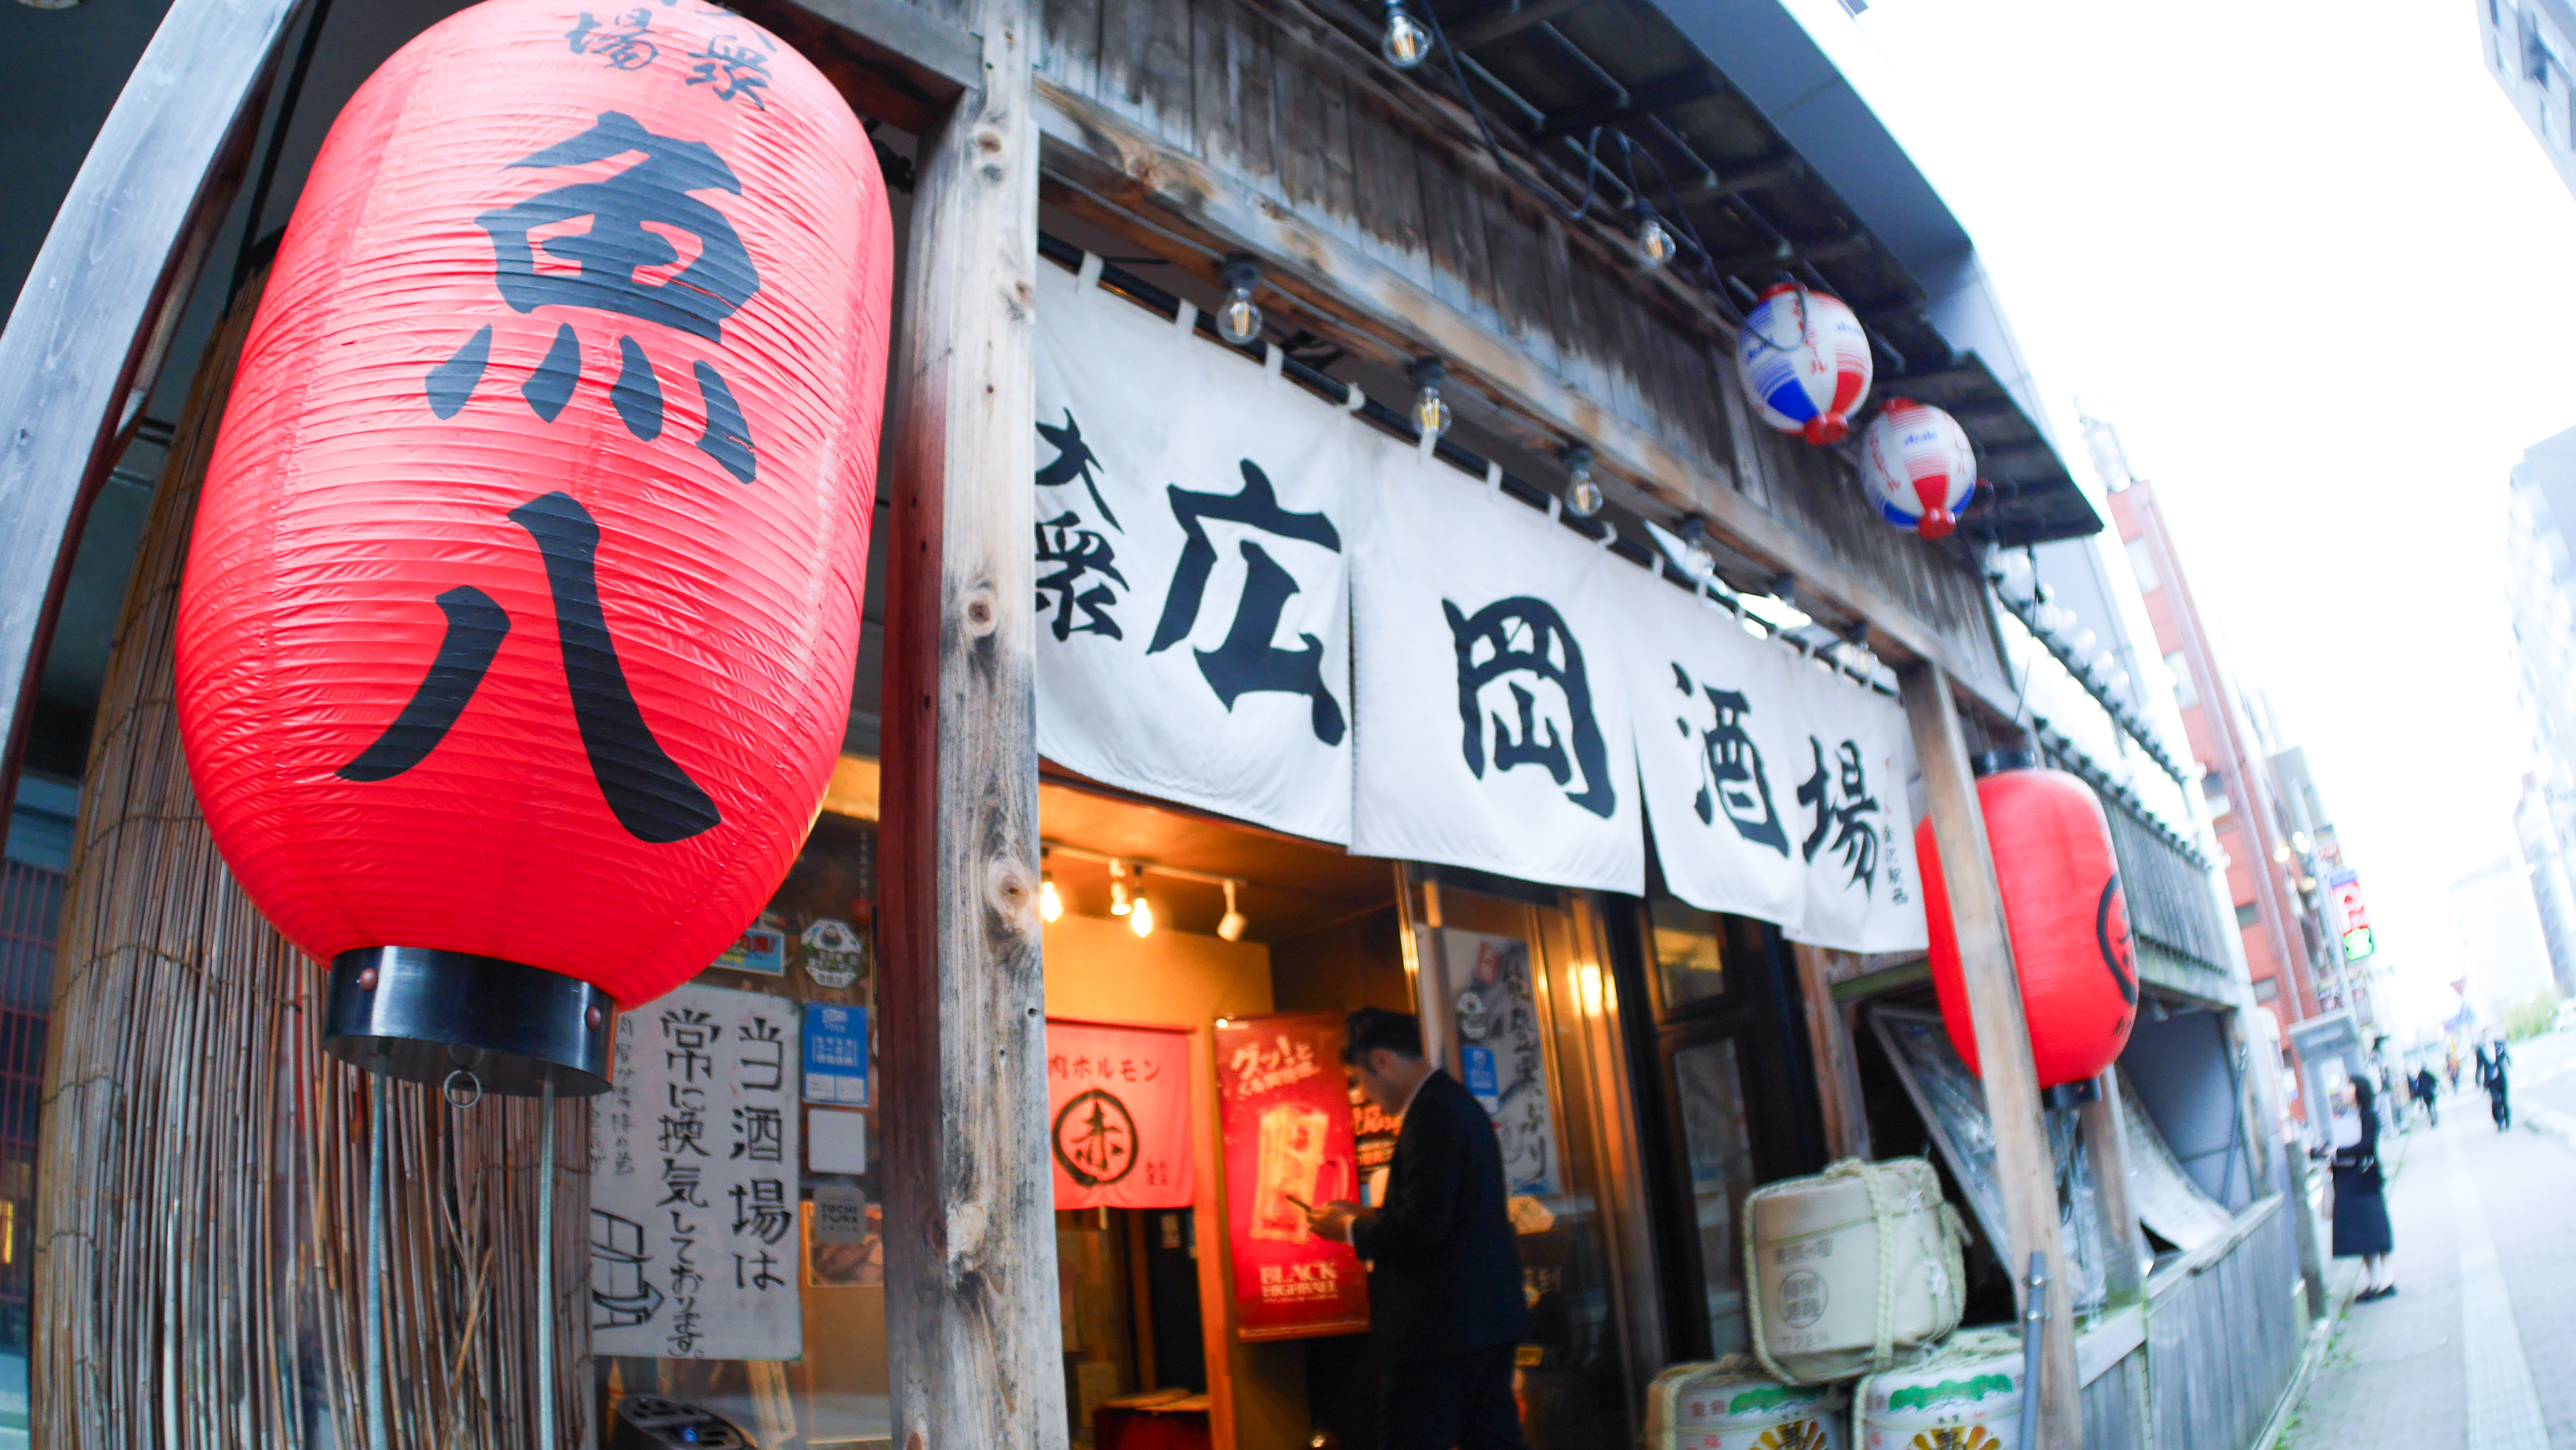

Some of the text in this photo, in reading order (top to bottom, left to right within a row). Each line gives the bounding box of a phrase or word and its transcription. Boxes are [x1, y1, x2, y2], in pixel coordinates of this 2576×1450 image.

[335, 110, 761, 843] 魚八
[1146, 457, 1880, 899] 広岡酒場
[729, 1017, 792, 1291] 当酒場は
